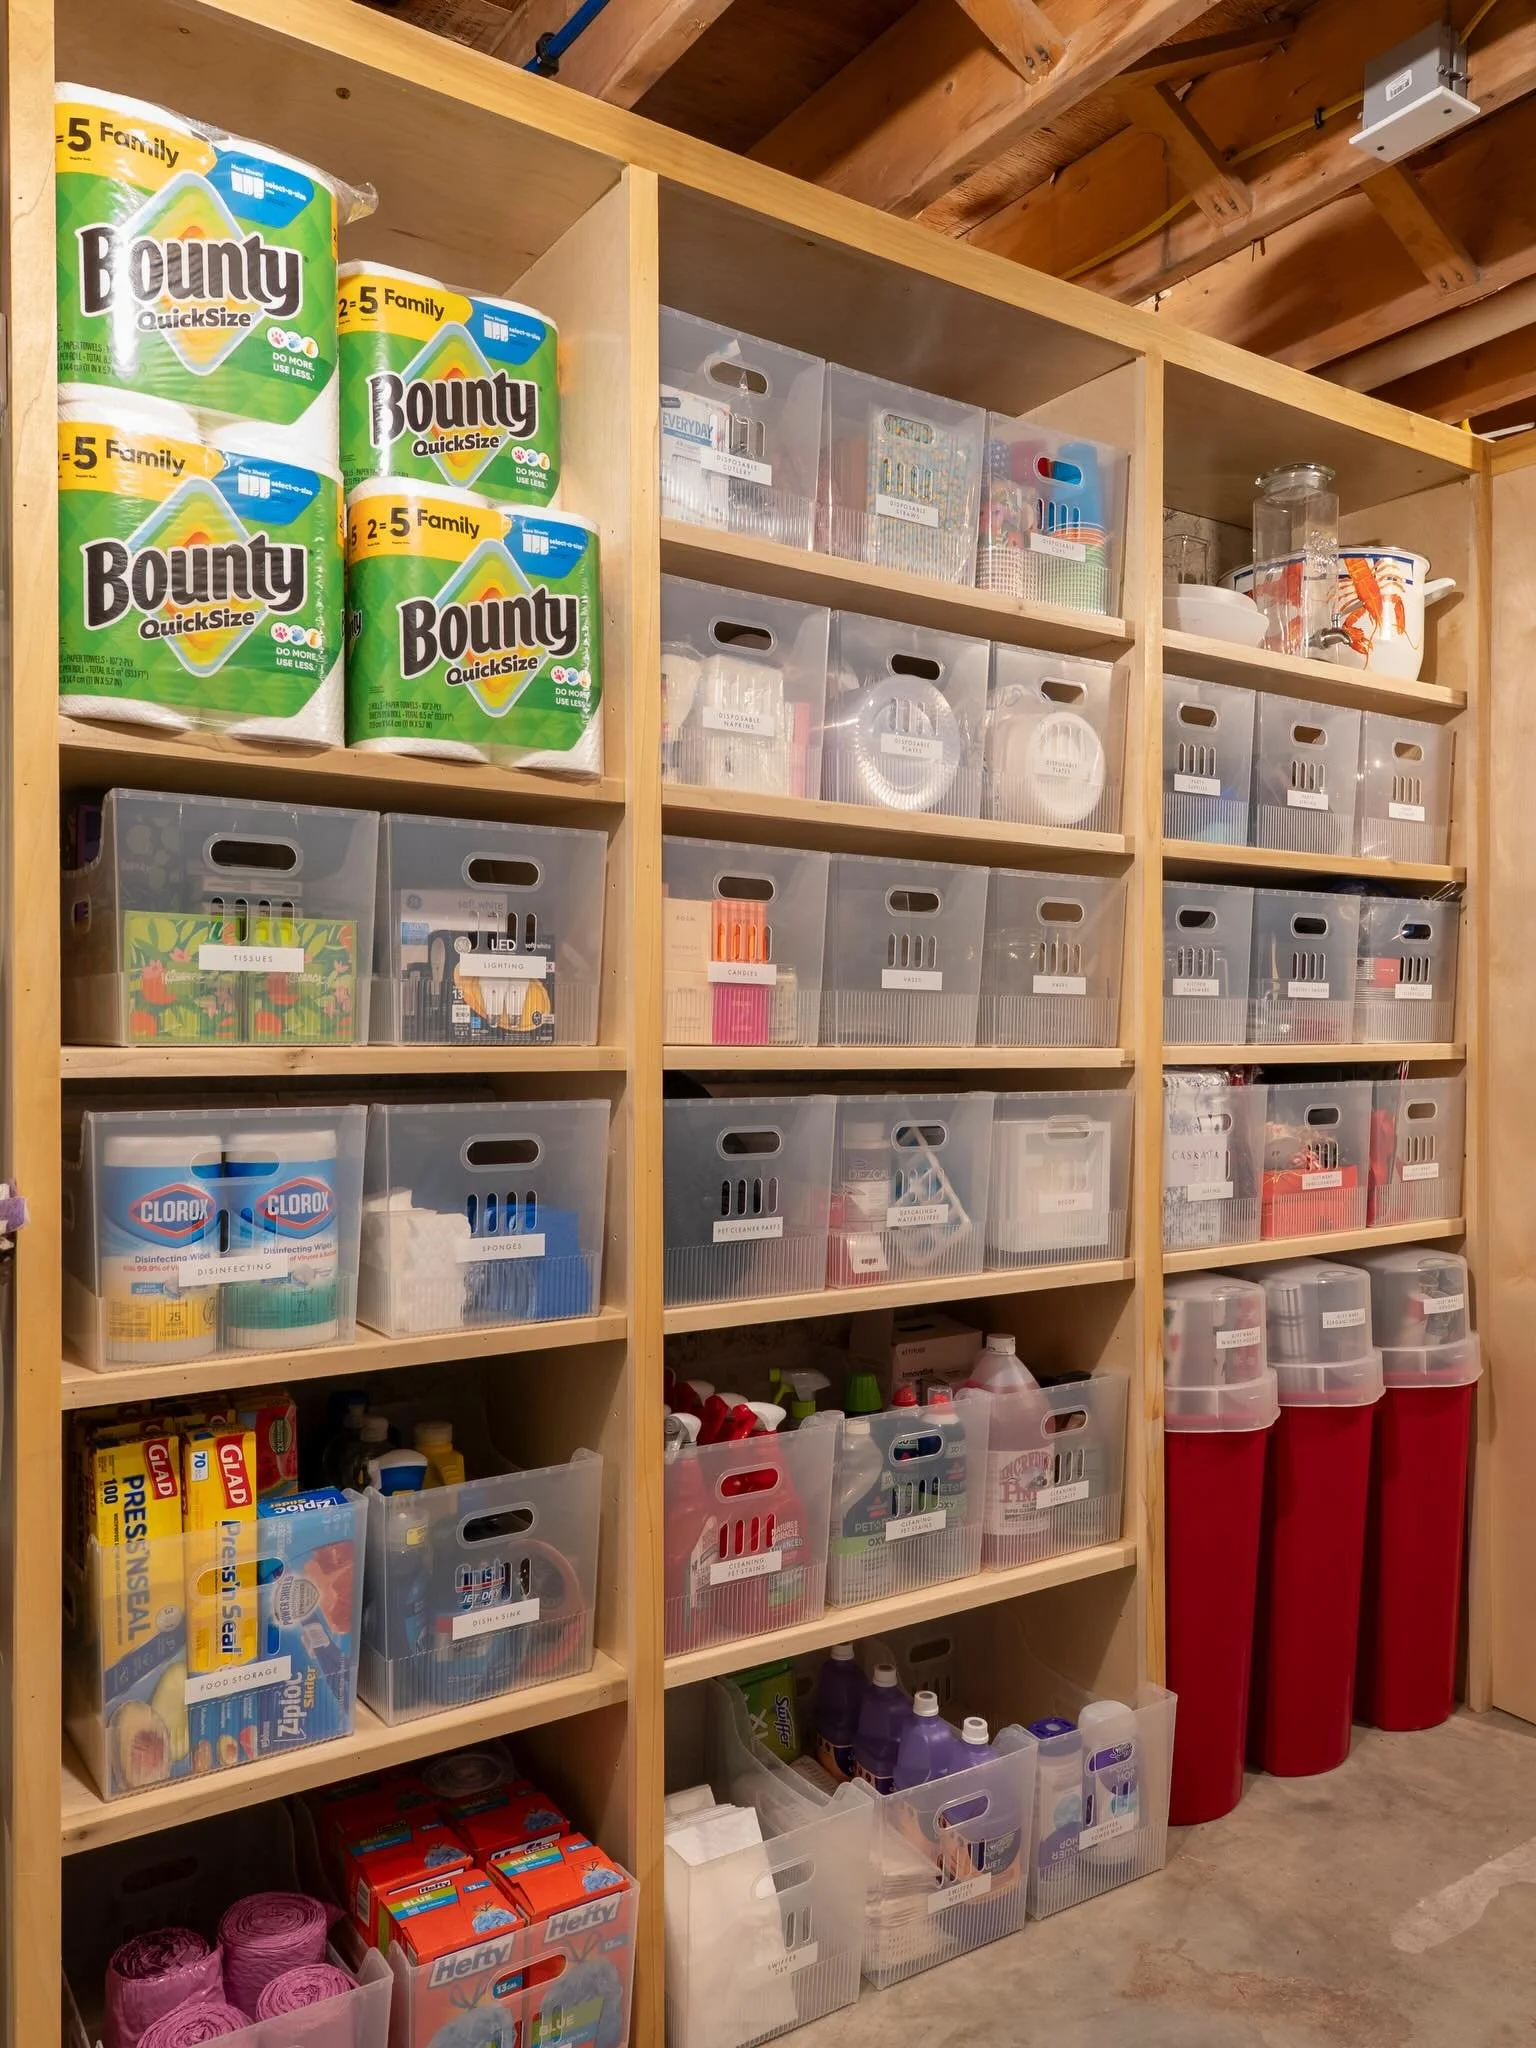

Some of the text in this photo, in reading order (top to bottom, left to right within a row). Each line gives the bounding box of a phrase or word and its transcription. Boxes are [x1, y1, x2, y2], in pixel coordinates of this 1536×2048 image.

[99, 121, 179, 168] Family
[79, 227, 300, 317] Bounty
[384, 288, 445, 321] Family
[137, 307, 252, 330] QuickSize
[273, 352, 287, 362] DO
[273, 363, 290, 374] USE
[371, 371, 536, 445] Bounty
[662, 412, 713, 440] EVERYDAY
[413, 435, 500, 457] QuickSize
[106, 439, 186, 477] Family
[717, 455, 757, 471] DISPOSABLE
[516, 467, 528, 476] DO
[516, 477, 529, 486] USE
[417, 509, 480, 539] Family
[85, 534, 305, 627] Bounty
[140, 608, 255, 640] QuickSize
[400, 588, 578, 677] Bounty
[276, 647, 290, 656] DO
[276, 658, 292, 667] USE
[446, 656, 538, 684] QuickSize
[555, 688, 567, 697] DO
[555, 697, 569, 706] USE
[719, 713, 760, 723] DISPOSABLE
[491, 938, 516, 951] LED
[234, 954, 273, 963] TISSUES
[483, 962, 525, 971] LIGHTING
[140, 1199, 208, 1223] CLOROX
[267, 1192, 329, 1216] CLOROX
[263, 1245, 312, 1255] Disinfecting
[482, 1243, 522, 1252] SPONGES
[135, 1253, 187, 1264] Disinfecting
[198, 1262, 272, 1276] DISINFECTING
[194, 1453, 206, 1468] 70
[149, 1444, 174, 1496] GLAD
[220, 1444, 247, 1505] GLAD
[103, 1478, 118, 1505] 100
[274, 1499, 331, 1515] Ziploc
[901, 1516, 932, 1528] CLEANING
[729, 1558, 765, 1570] CLEANING
[473, 1617, 492, 1627] DISH
[502, 1610, 521, 1621] SINK
[200, 1666, 279, 1692] FOOD STORAGE
[277, 1671, 306, 1738] Ziploc
[775, 1693, 792, 1748] Swiffer
[421, 1881, 452, 1894] Hefty
[402, 1894, 433, 1908] BLUE
[548, 1902, 616, 1939] Hefty
[436, 1943, 512, 1982] Hefty
[496, 1983, 507, 1994] 13
[539, 2014, 576, 2037] BLUE
